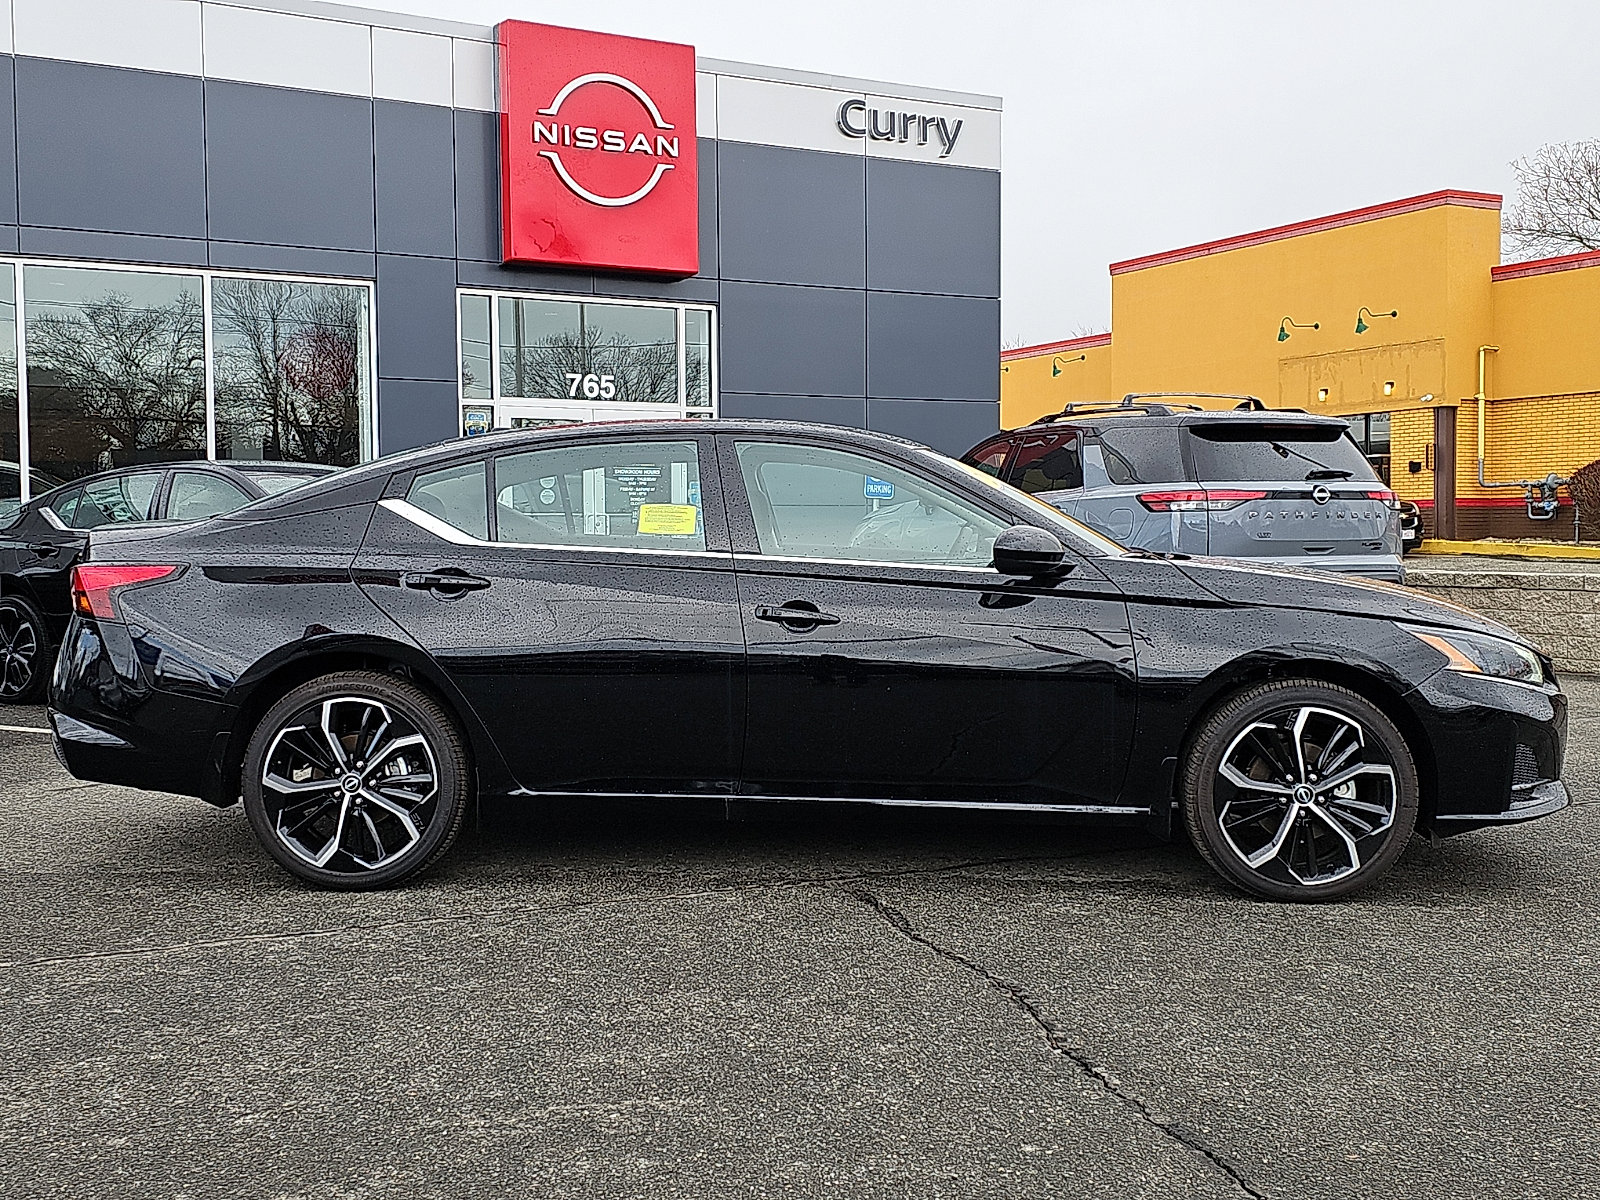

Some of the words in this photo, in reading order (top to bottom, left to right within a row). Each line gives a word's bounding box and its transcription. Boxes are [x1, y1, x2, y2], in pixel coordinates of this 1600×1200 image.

[533, 119, 680, 158] NISSAN
[835, 98, 964, 158] Curry
[565, 373, 616, 399] 765
[867, 484, 892, 494] PARKING
[1248, 511, 1382, 520] PATHFINDER
